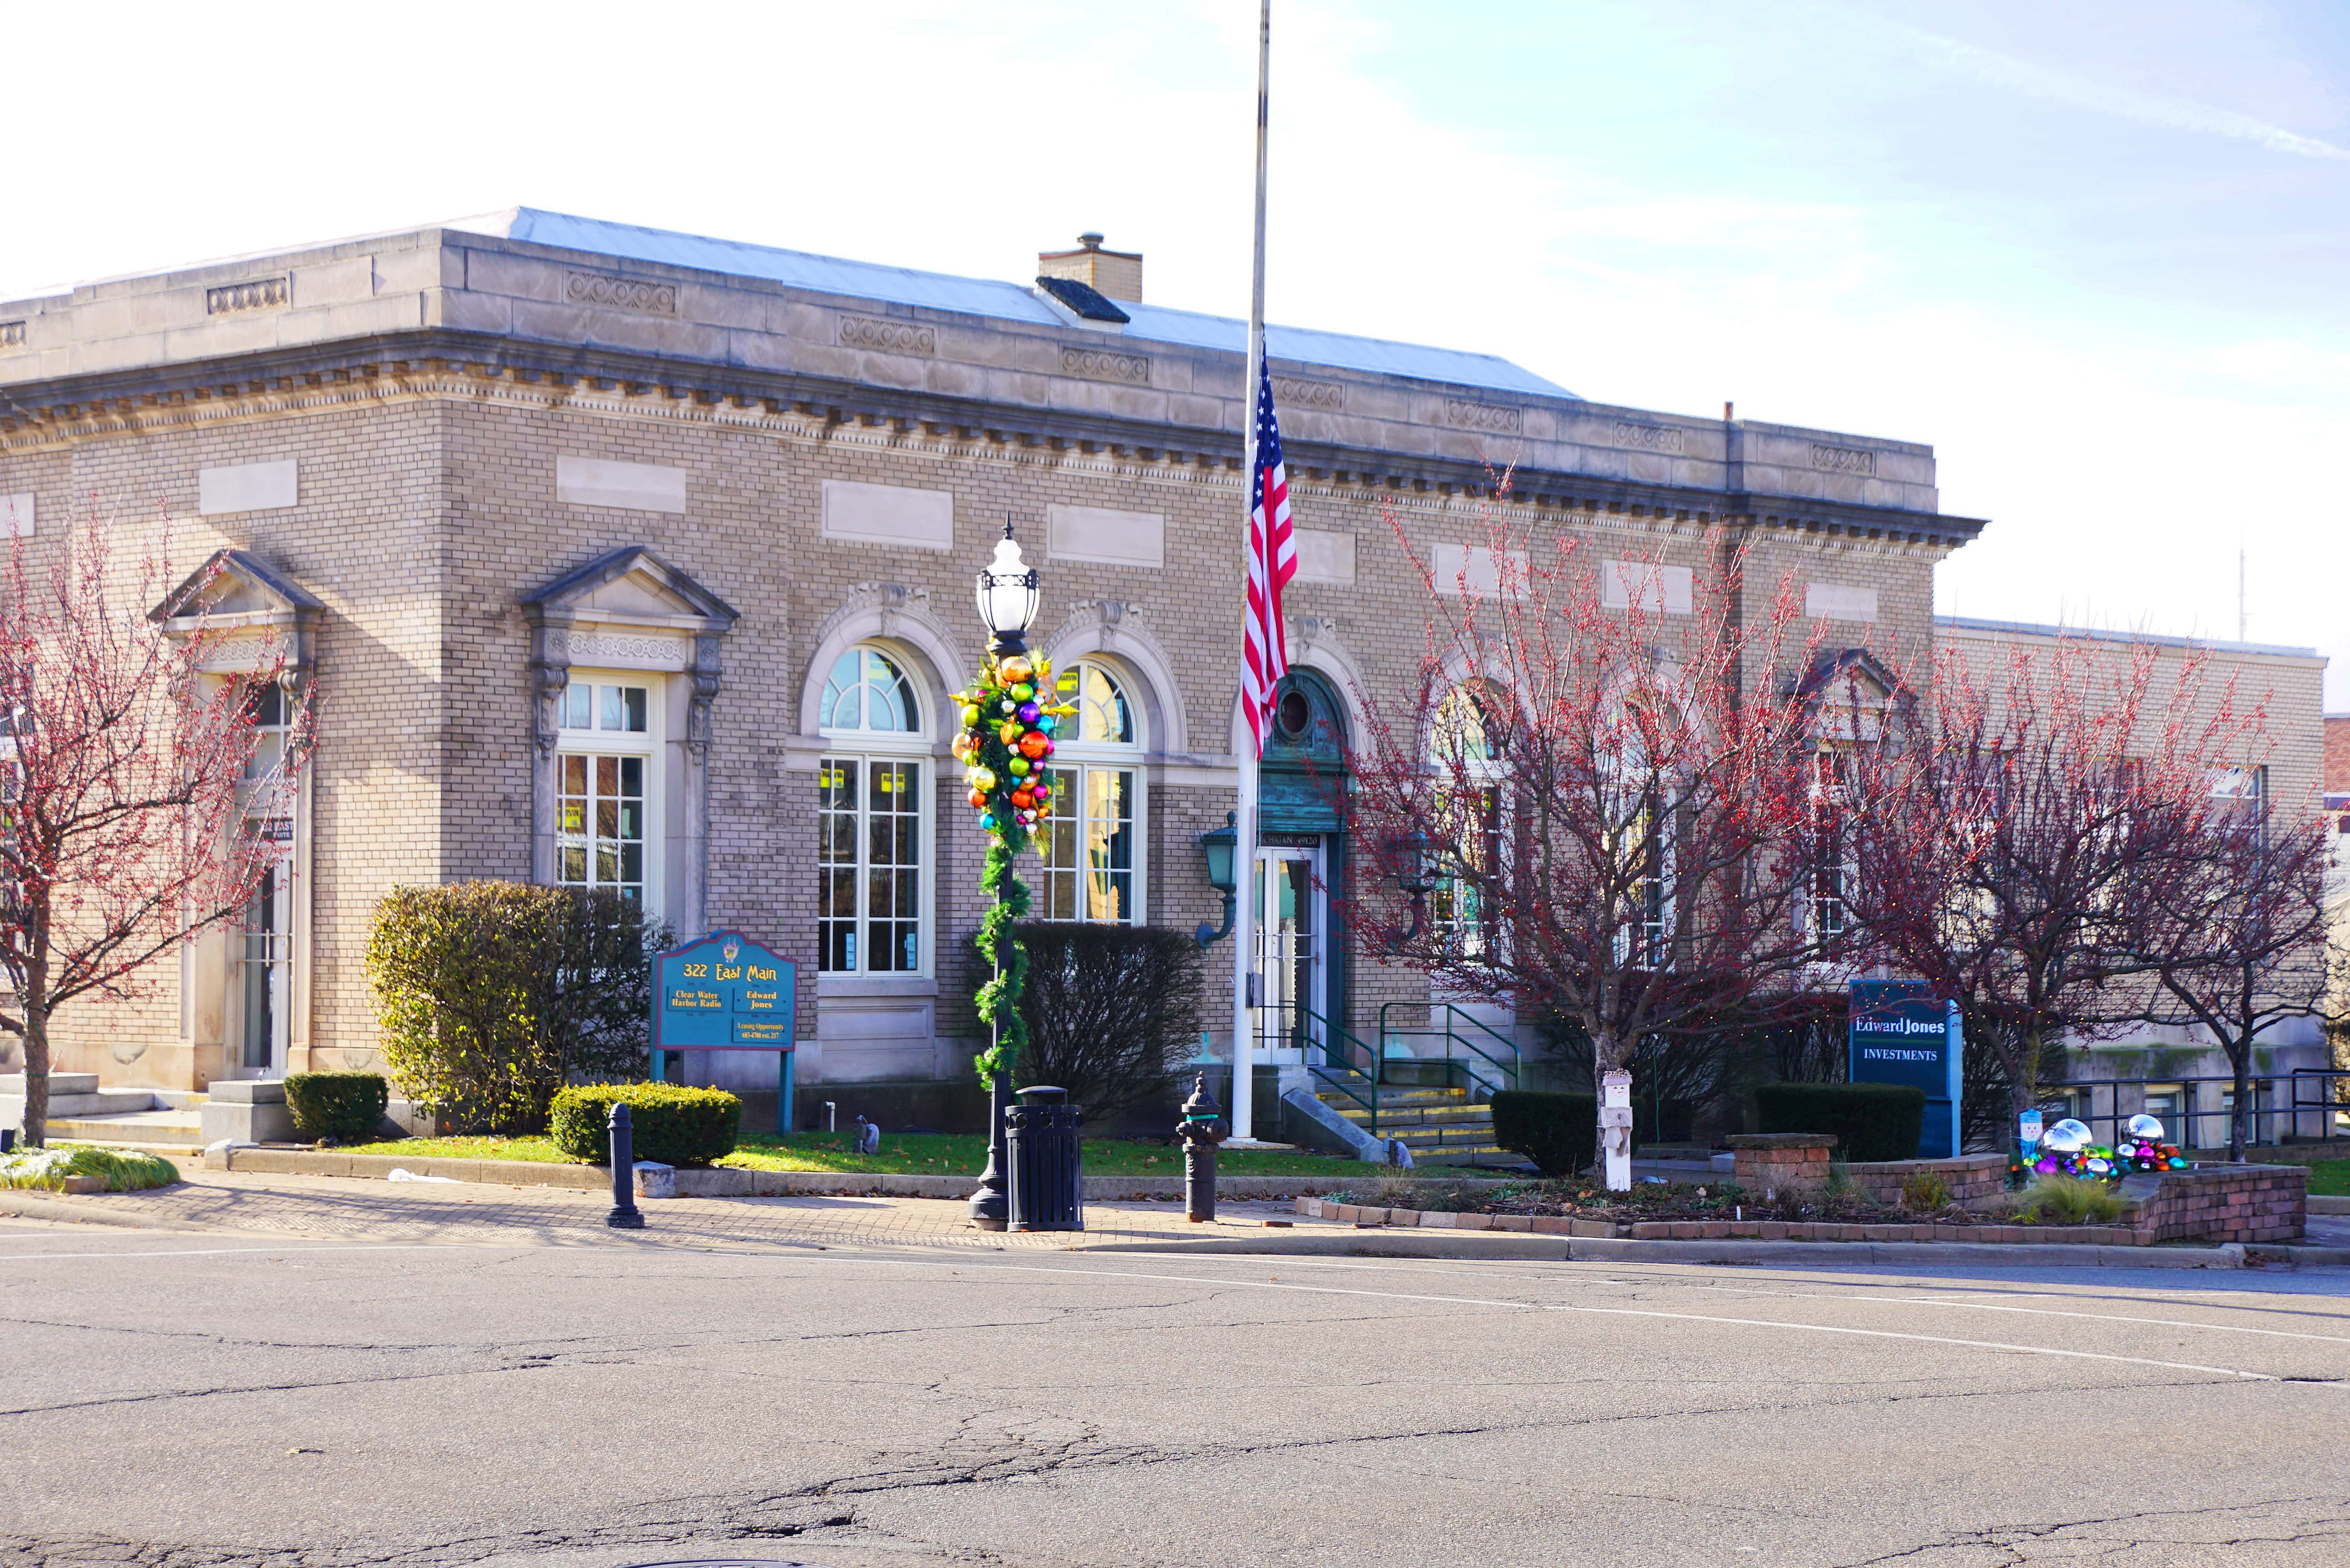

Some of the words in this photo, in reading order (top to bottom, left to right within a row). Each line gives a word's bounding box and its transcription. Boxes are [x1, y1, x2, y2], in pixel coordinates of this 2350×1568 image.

[1263, 835, 1293, 844] CHIGAN
[1297, 836, 1317, 844] 49120
[683, 963, 708, 977] 322
[715, 963, 742, 981] East
[747, 965, 777, 982] Main
[675, 990, 695, 998] Clear
[697, 990, 718, 999] Water
[746, 990, 777, 1000] Edward
[672, 998, 698, 1006] Harbor
[700, 999, 722, 1008] Radio
[750, 1000, 773, 1010] Jones
[738, 1022, 755, 1030] Leasing
[756, 1022, 784, 1032] Opportunity
[1864, 1048, 1937, 1061] INVESTMENTS
